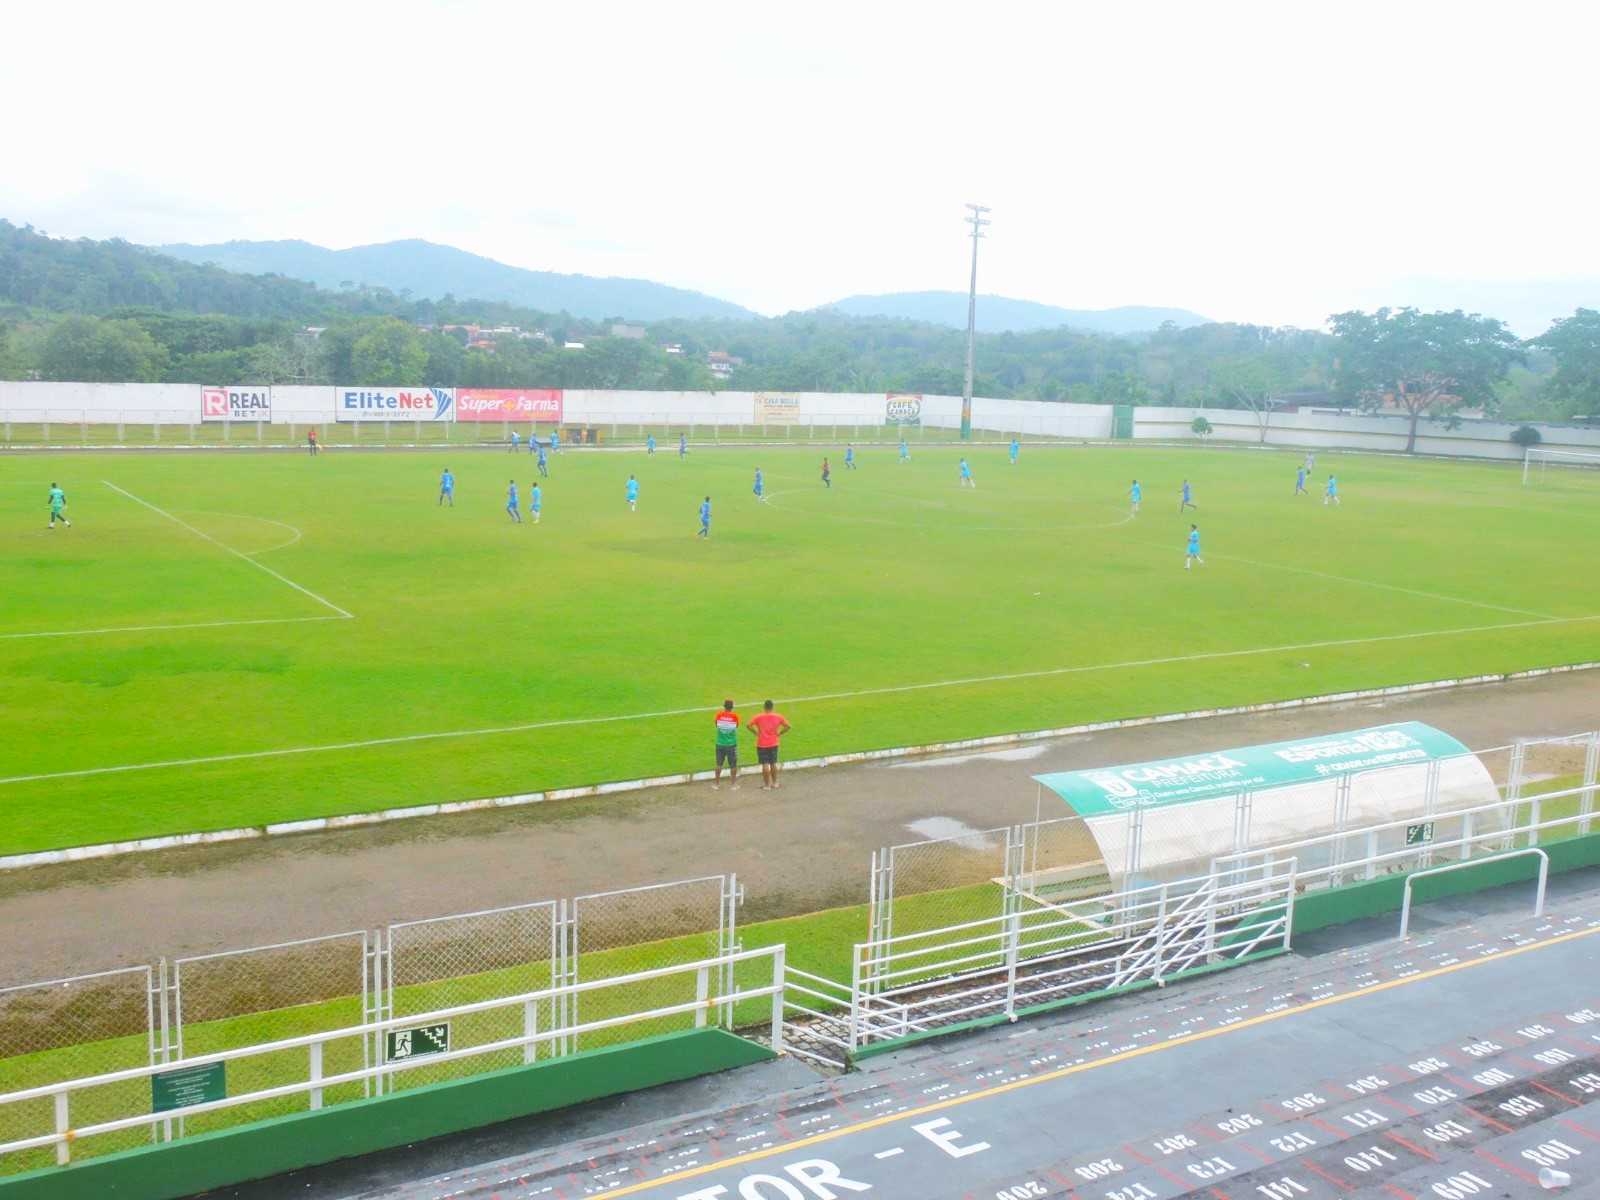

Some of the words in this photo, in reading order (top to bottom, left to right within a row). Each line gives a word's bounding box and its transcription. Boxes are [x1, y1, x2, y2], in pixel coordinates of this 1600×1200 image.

[229, 393, 269, 409] REAL
[344, 391, 434, 409] EliteNet
[459, 395, 505, 414] Super
[516, 396, 560, 412] Farma
[911, 1117, 991, 1159] E
